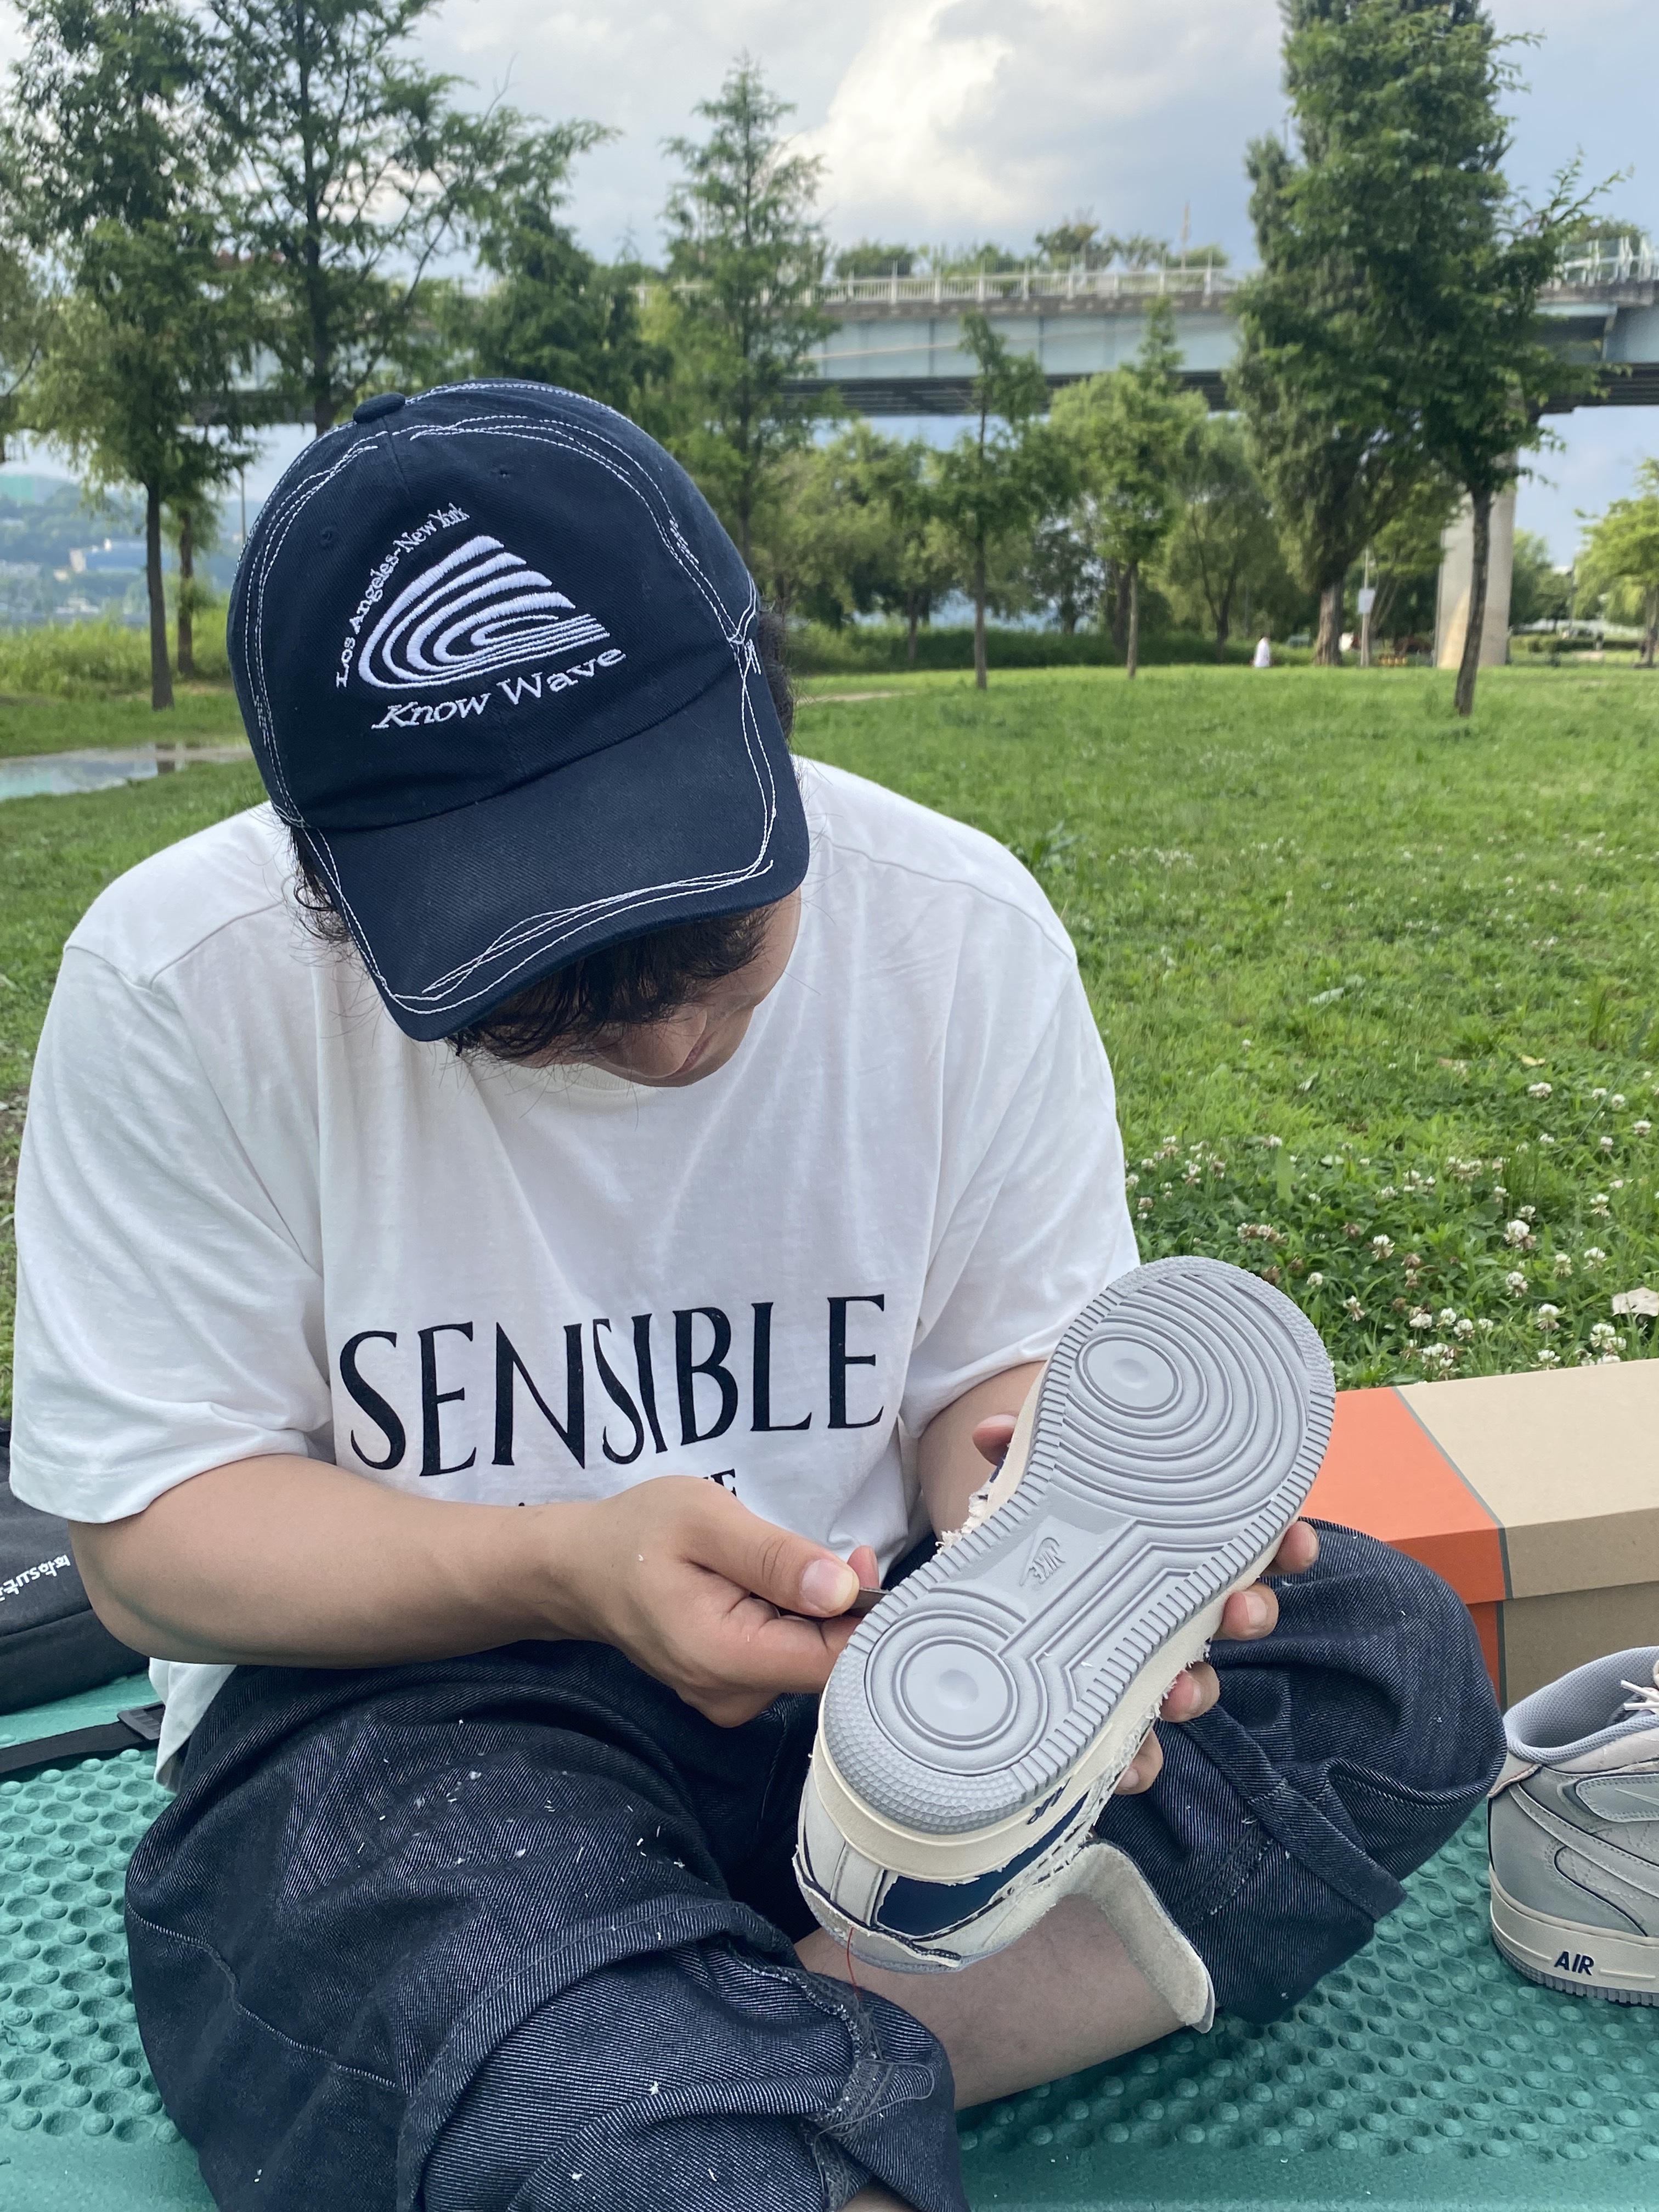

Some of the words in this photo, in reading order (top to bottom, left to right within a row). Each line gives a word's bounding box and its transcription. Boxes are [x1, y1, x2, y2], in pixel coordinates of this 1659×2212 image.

[335, 636, 356, 688] Los
[371, 692, 492, 730] Know
[496, 648, 627, 705] Wave
[339, 1294, 885, 1477] SENSIBLE
[1554, 1950, 1594, 1976] AIR
